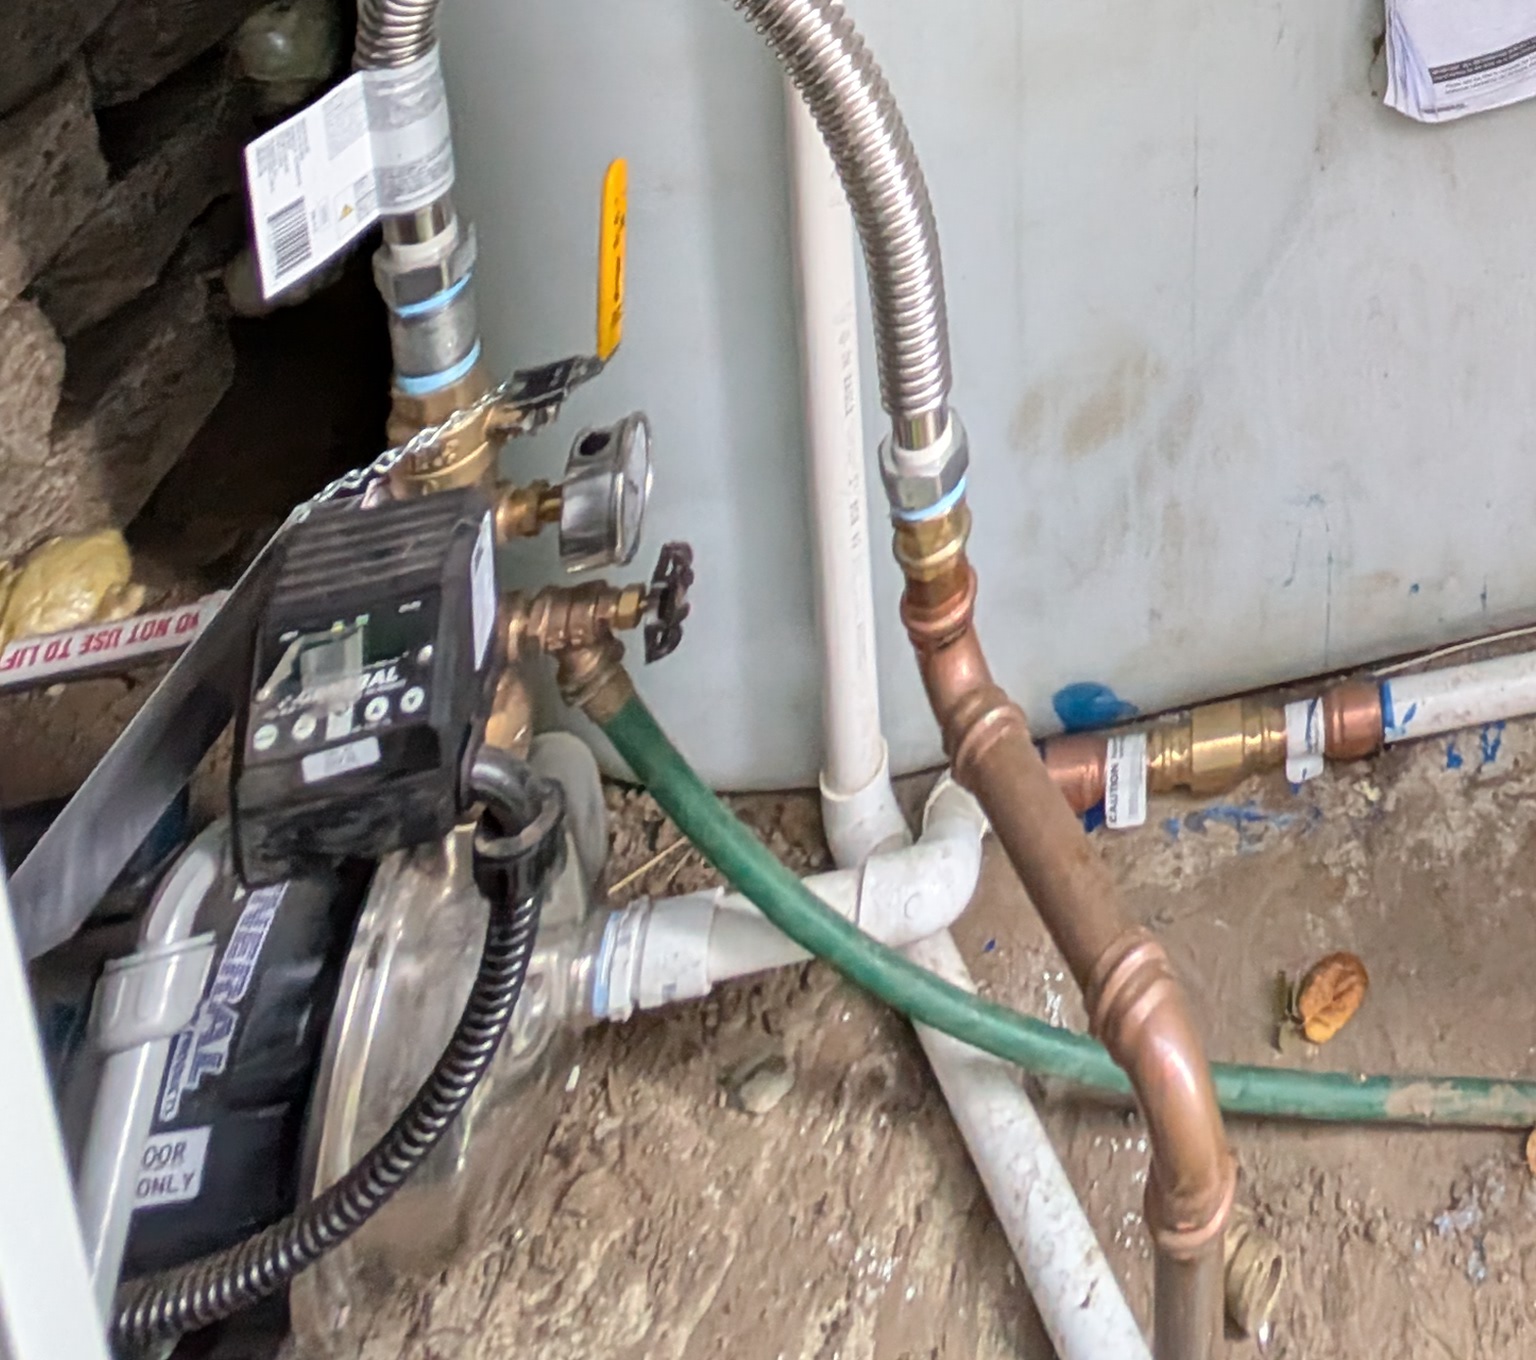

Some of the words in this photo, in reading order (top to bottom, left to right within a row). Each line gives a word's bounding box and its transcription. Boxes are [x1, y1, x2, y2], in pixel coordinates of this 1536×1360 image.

[78, 626, 124, 656] USE
[125, 616, 173, 644] NOT
[43, 636, 73, 662] TO
[1109, 763, 1120, 823] CAUTION
[190, 884, 285, 1086] NERAL
[142, 1141, 187, 1170] OOR
[136, 1169, 195, 1198] ONLY
